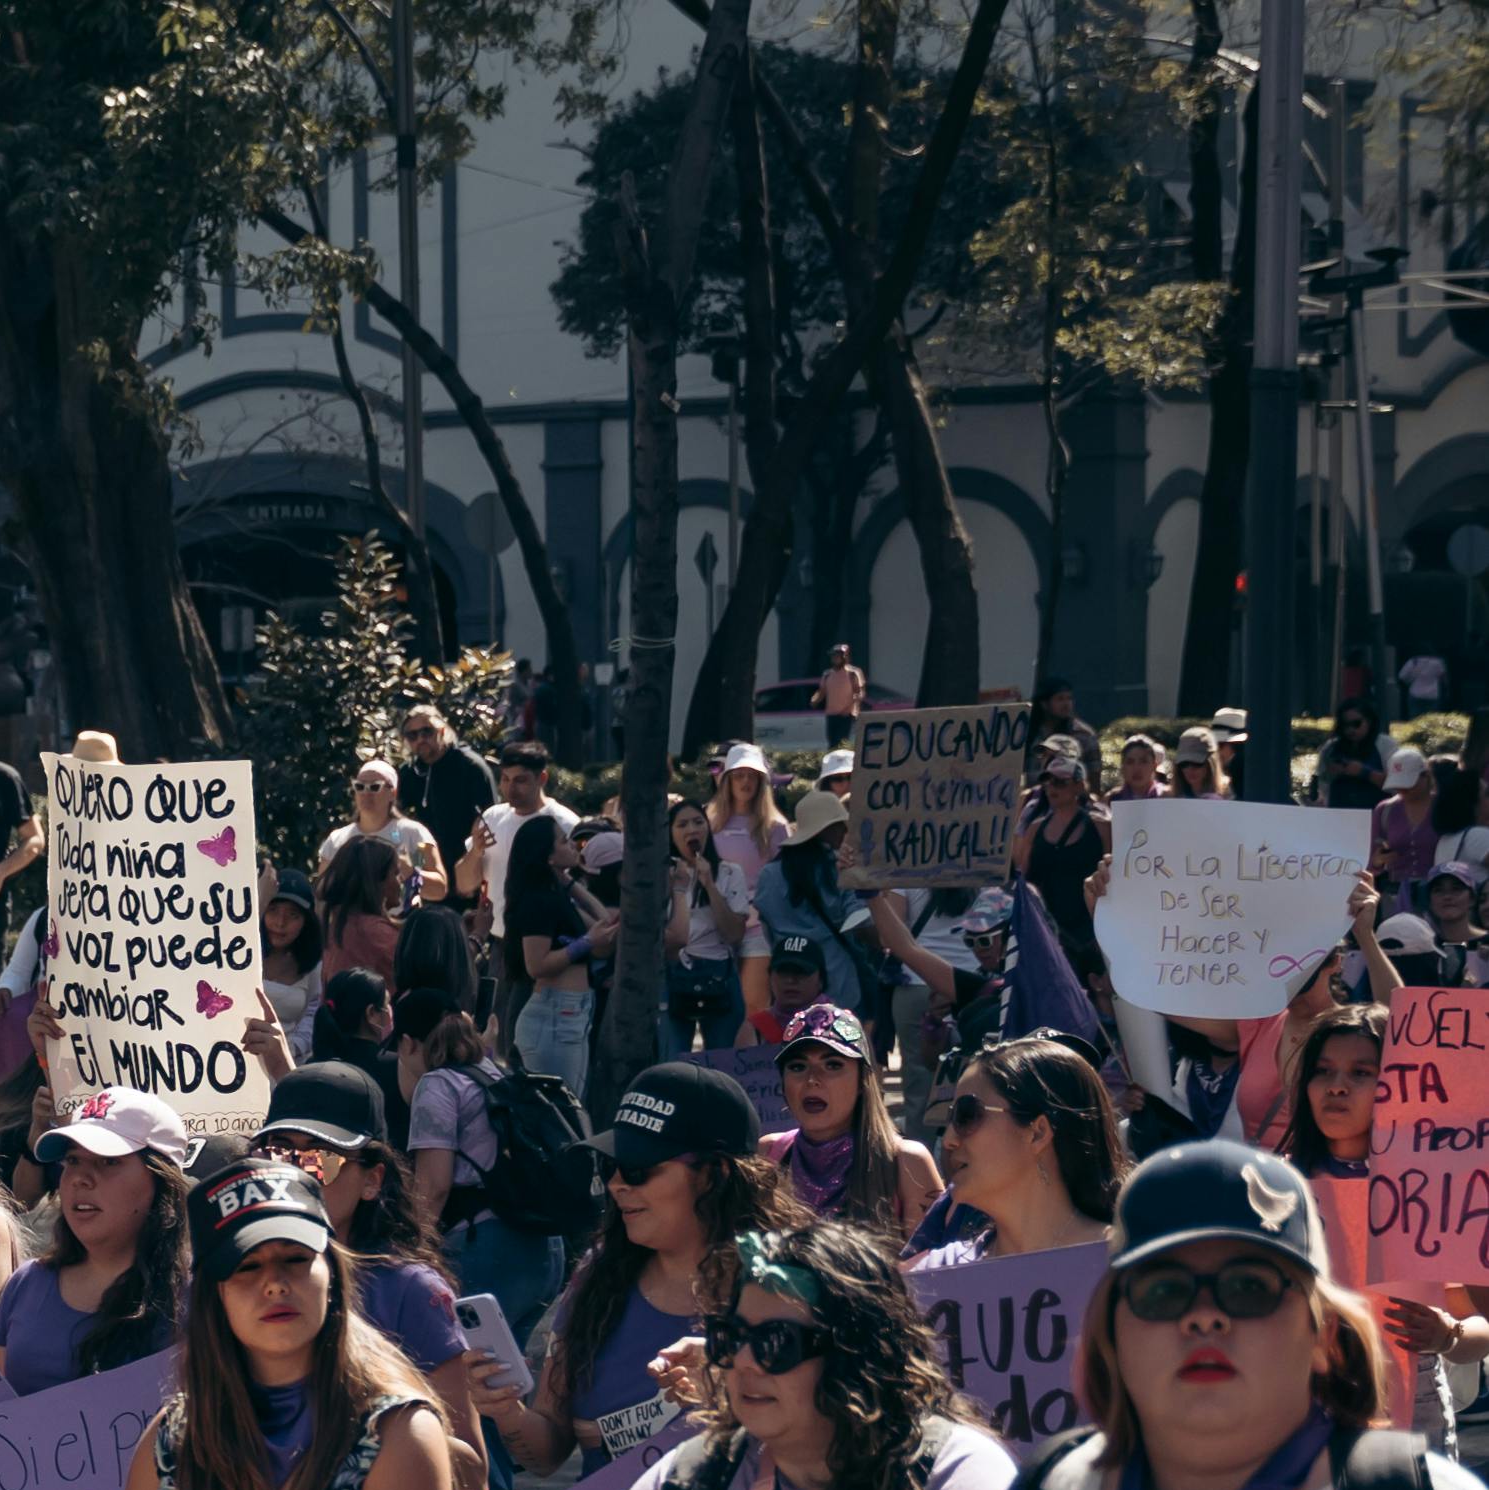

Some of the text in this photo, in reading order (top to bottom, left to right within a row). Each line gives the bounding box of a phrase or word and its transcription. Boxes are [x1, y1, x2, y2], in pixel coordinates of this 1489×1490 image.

[860, 706, 1030, 770] EDUCANDO
[784, 936, 808, 952] GAP
[1391, 990, 1489, 1050] VUEL
[109, 1040, 246, 1094] MUNDO
[218, 1179, 294, 1218] BAX
[601, 1400, 664, 1434] DON'T FUCK
[606, 1422, 653, 1449] WITH MY
